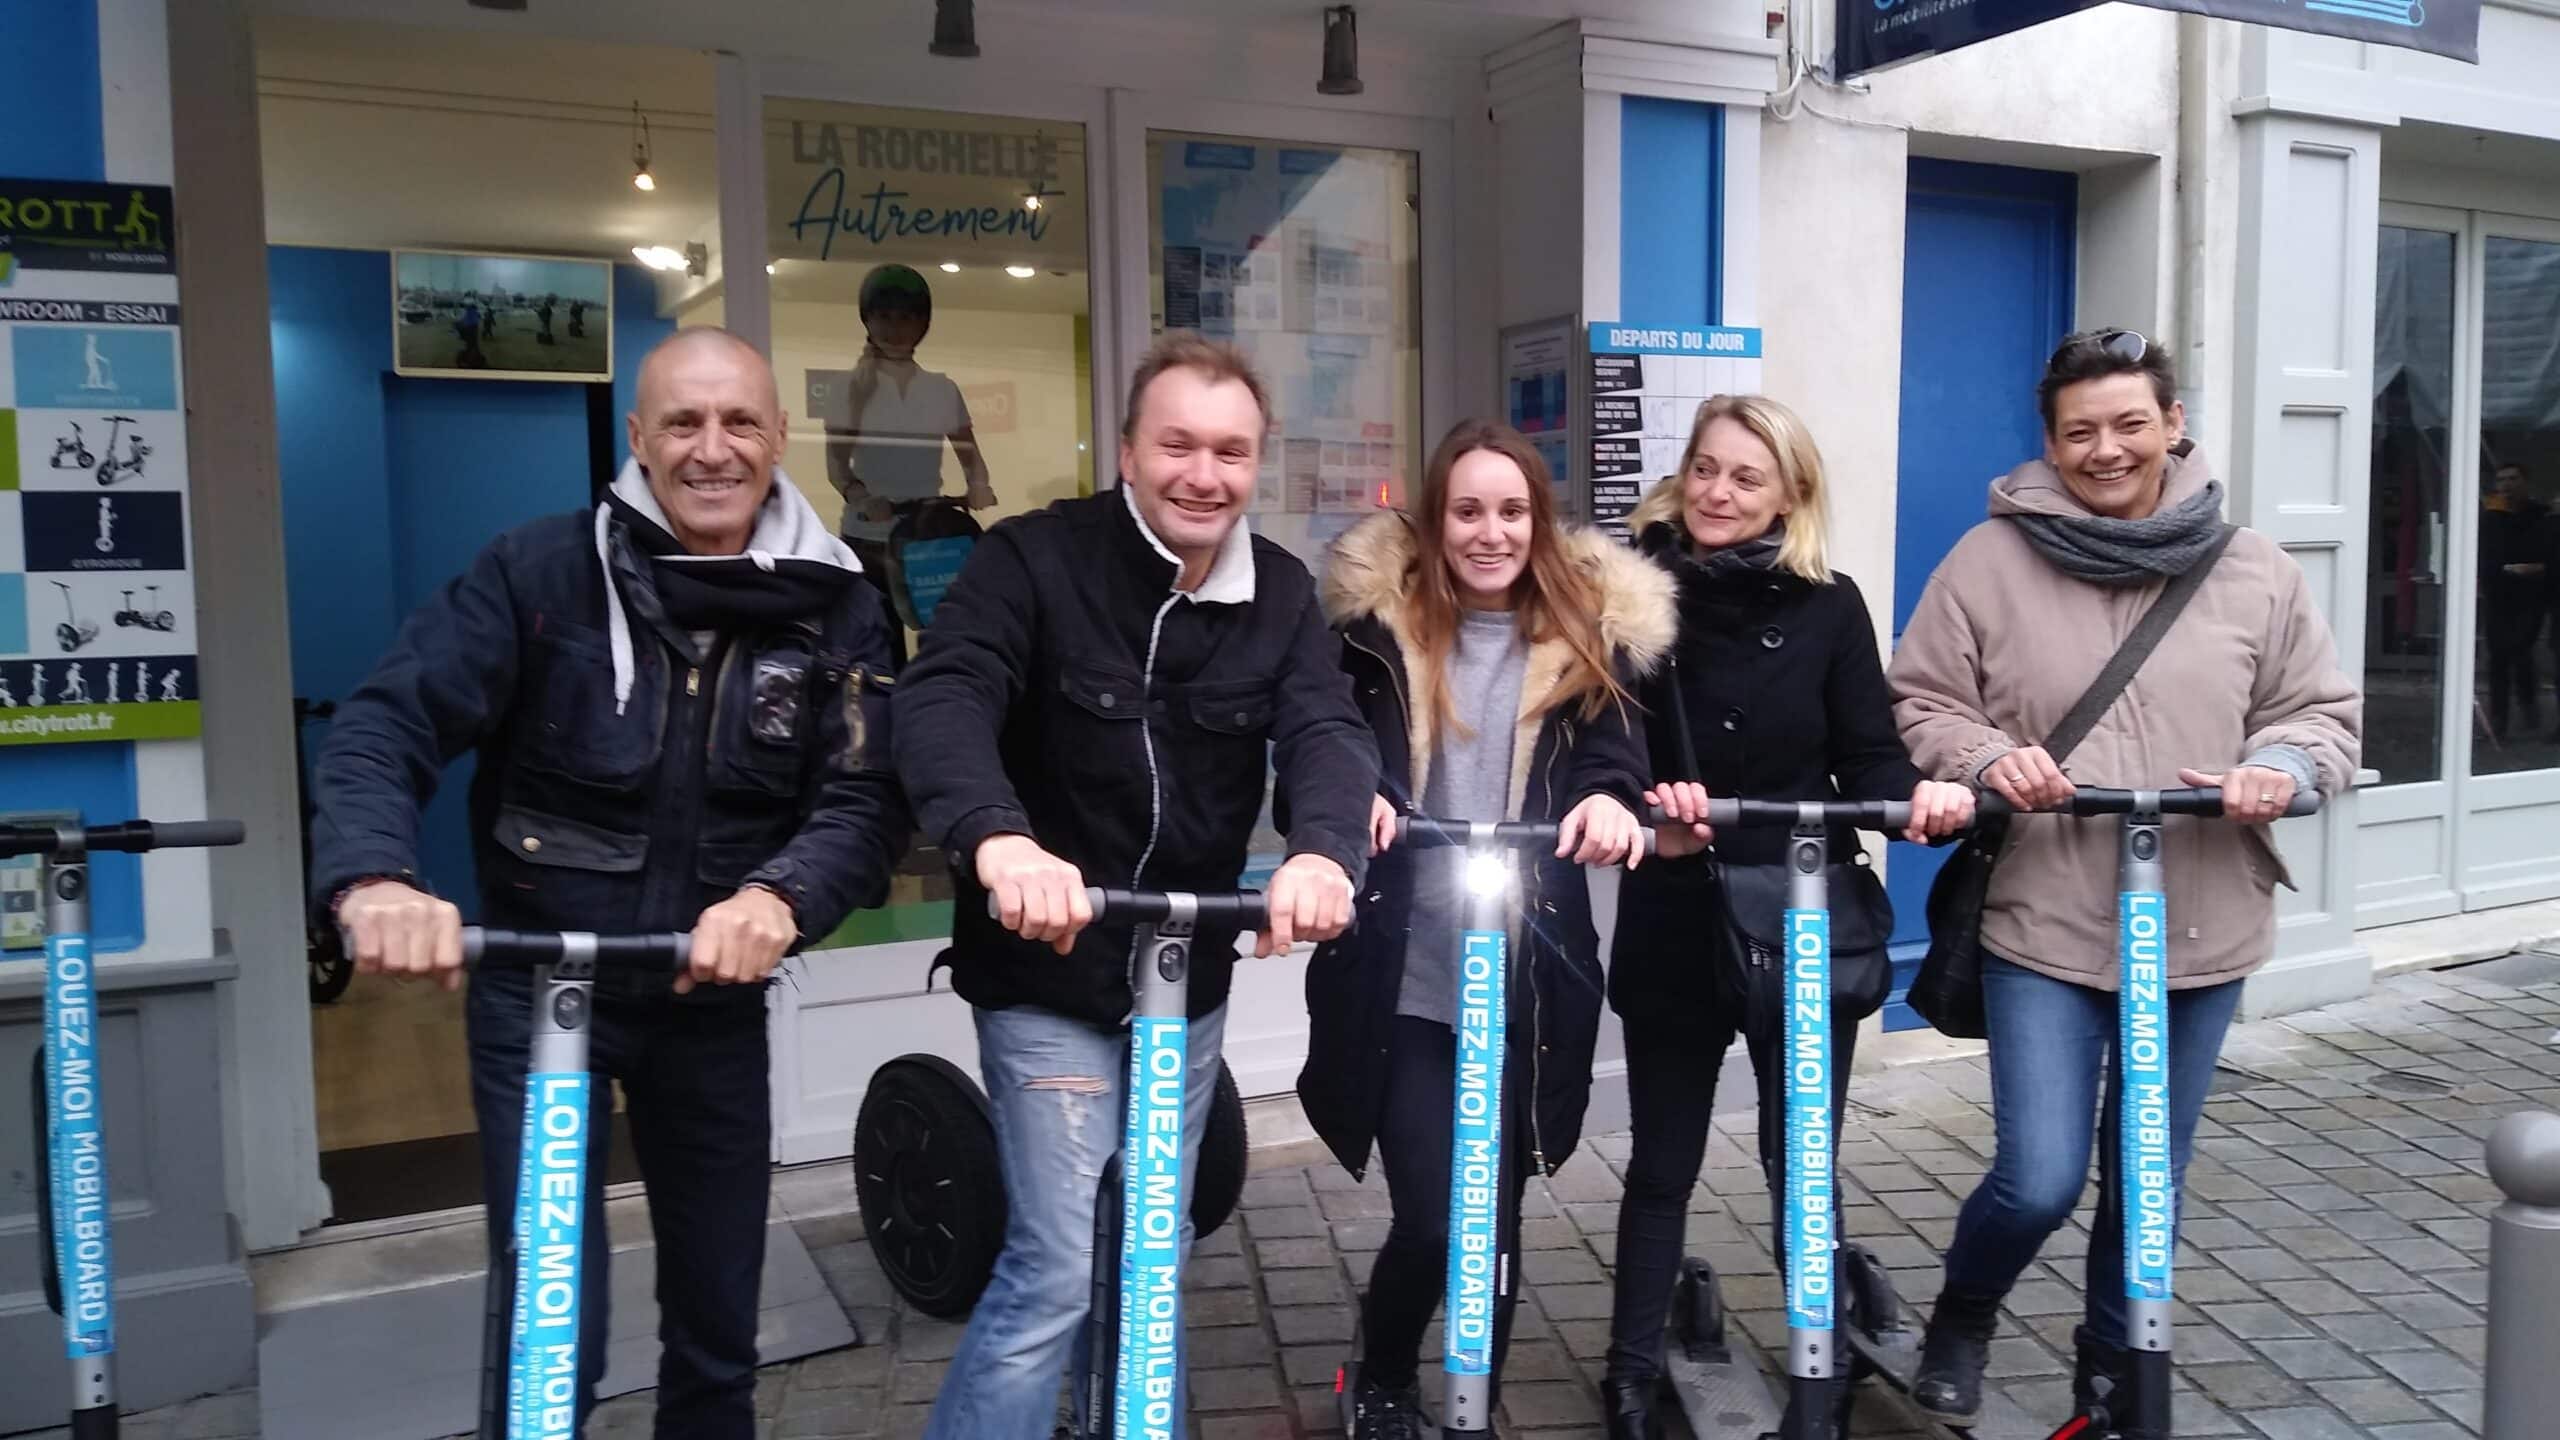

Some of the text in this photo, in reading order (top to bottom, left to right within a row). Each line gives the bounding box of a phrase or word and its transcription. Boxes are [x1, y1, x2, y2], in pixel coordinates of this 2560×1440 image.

[788, 167, 1066, 260] Autrement
[792, 120, 1058, 182] LA ROCHELLE
[103, 304, 168, 323] ESSAI
[1610, 329, 1745, 351] DEPARTS DU JOUR
[1795, 913, 1823, 1093] LOUEZ-MOI
[2129, 897, 2167, 1267] LOUEZ-MOI MOBILBOARD
[56, 938, 108, 1320] LOUEZ-MOI MOBILBOARD
[535, 1078, 580, 1328] LOUEZ-MOI
[1143, 1022, 1182, 1249] LOUEZ-MOI
[1460, 936, 1491, 1338] LOUEZ-MOI MOBILBOARD
[1803, 1106, 1828, 1295] MOBILBOARD
